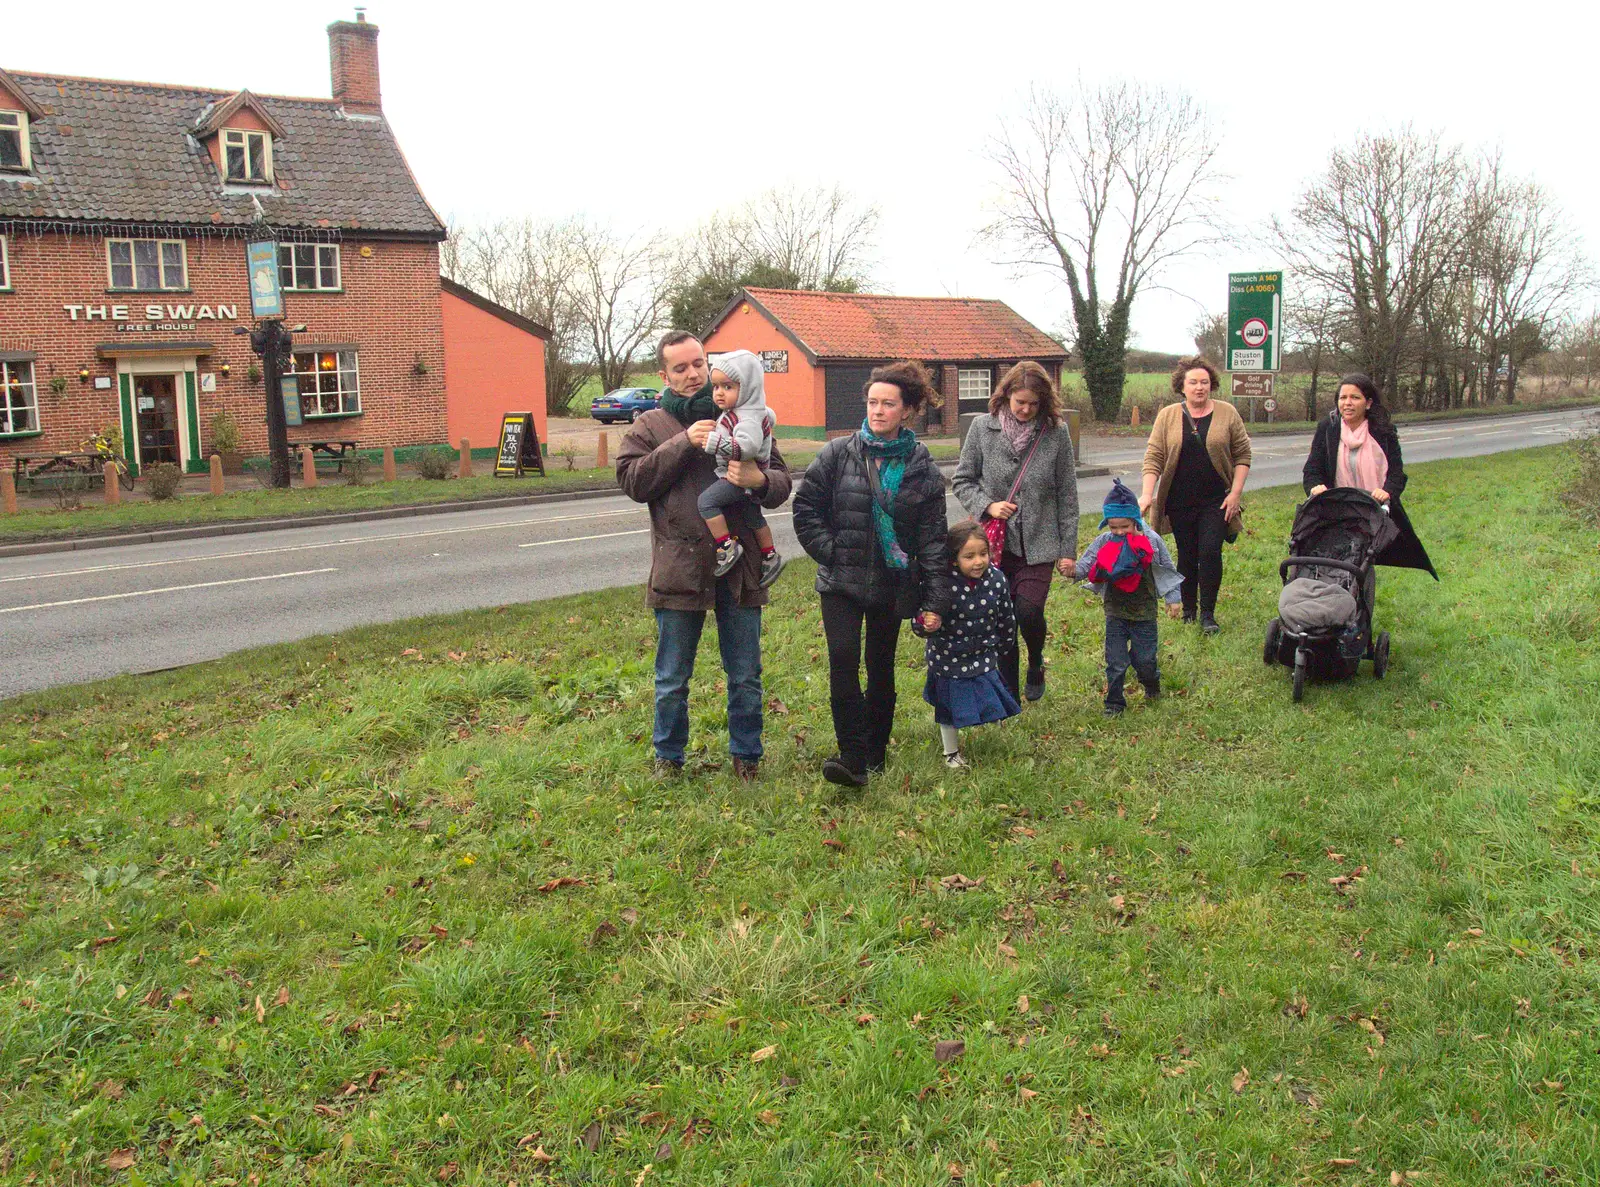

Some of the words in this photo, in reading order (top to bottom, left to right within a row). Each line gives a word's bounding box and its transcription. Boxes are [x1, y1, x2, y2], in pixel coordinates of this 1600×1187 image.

[1245, 285, 1255, 293] (A
[63, 304, 129, 320] THE
[145, 304, 237, 320] SWAN
[156, 323, 196, 331] HOUSE
